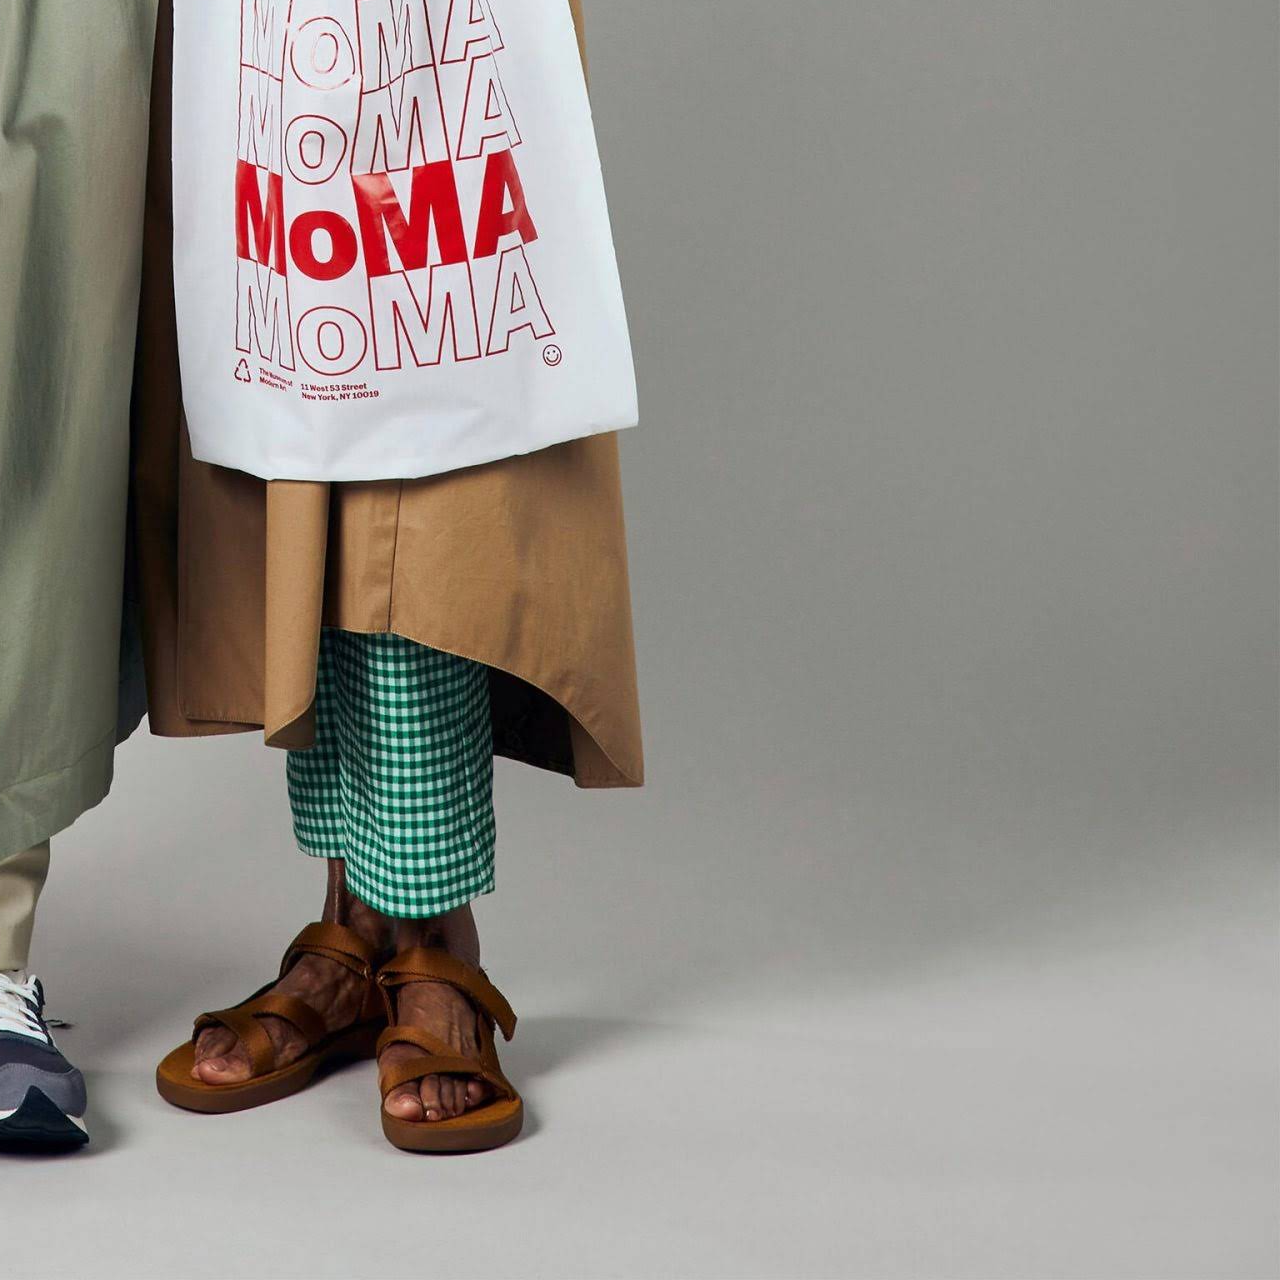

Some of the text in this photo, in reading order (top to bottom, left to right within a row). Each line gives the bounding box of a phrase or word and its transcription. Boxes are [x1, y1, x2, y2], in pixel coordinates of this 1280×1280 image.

[236, 51, 523, 186] MoMA
[234, 148, 539, 281] MoMA
[235, 244, 556, 376] MoMA
[300, 382, 368, 392] 11 West 53 Street
[302, 390, 380, 402] New York, NY 10019
